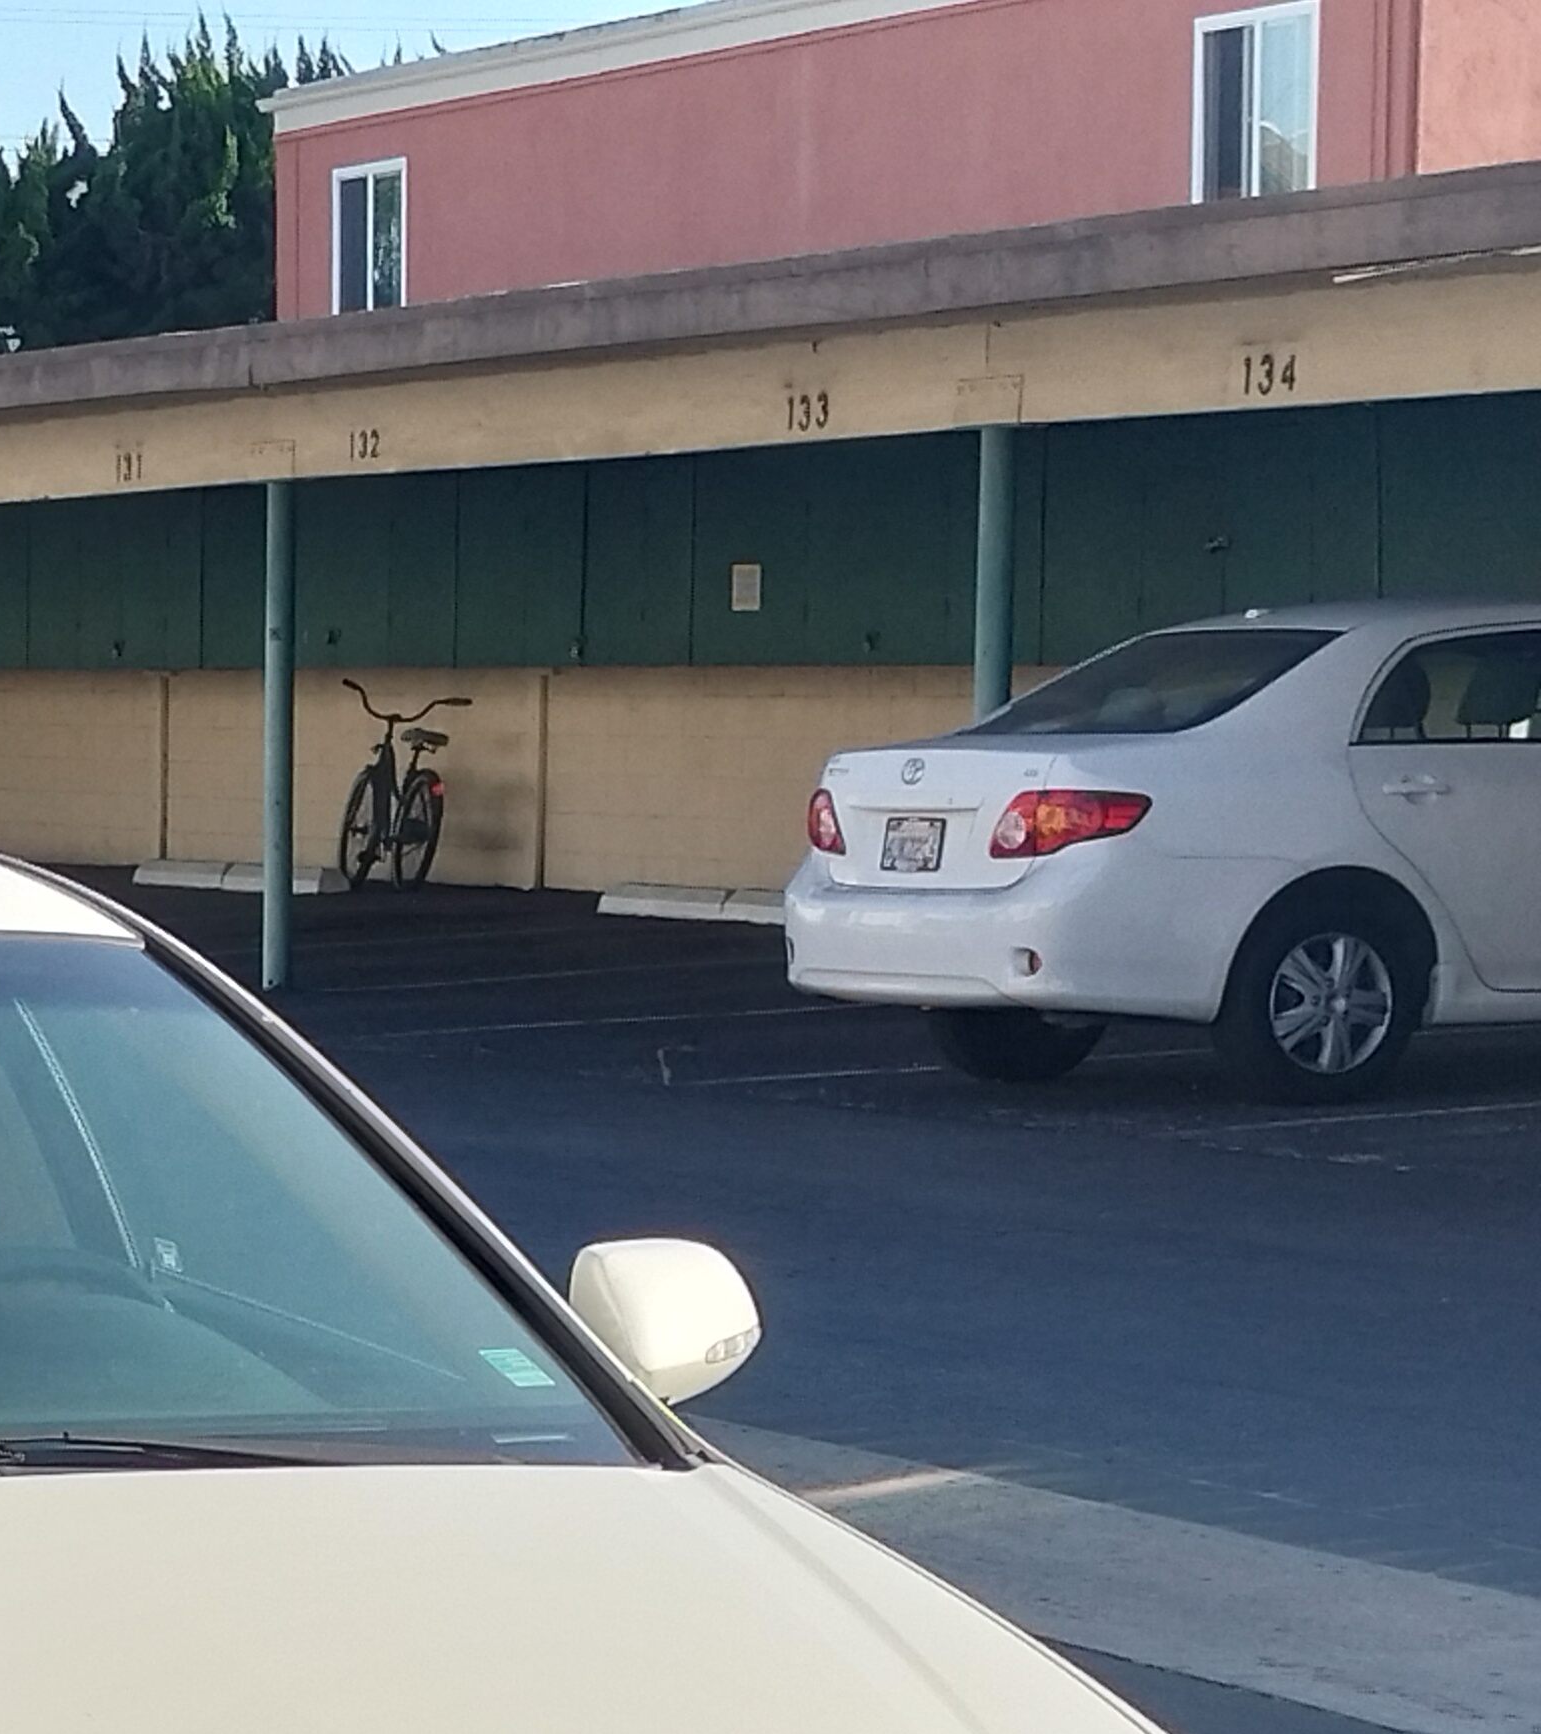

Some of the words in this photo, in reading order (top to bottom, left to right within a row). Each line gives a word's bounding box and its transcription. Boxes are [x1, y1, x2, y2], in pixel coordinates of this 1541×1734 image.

[1243, 354, 1296, 396] 134
[787, 391, 829, 432] 133
[349, 429, 382, 462] 132
[116, 452, 142, 483] 131
